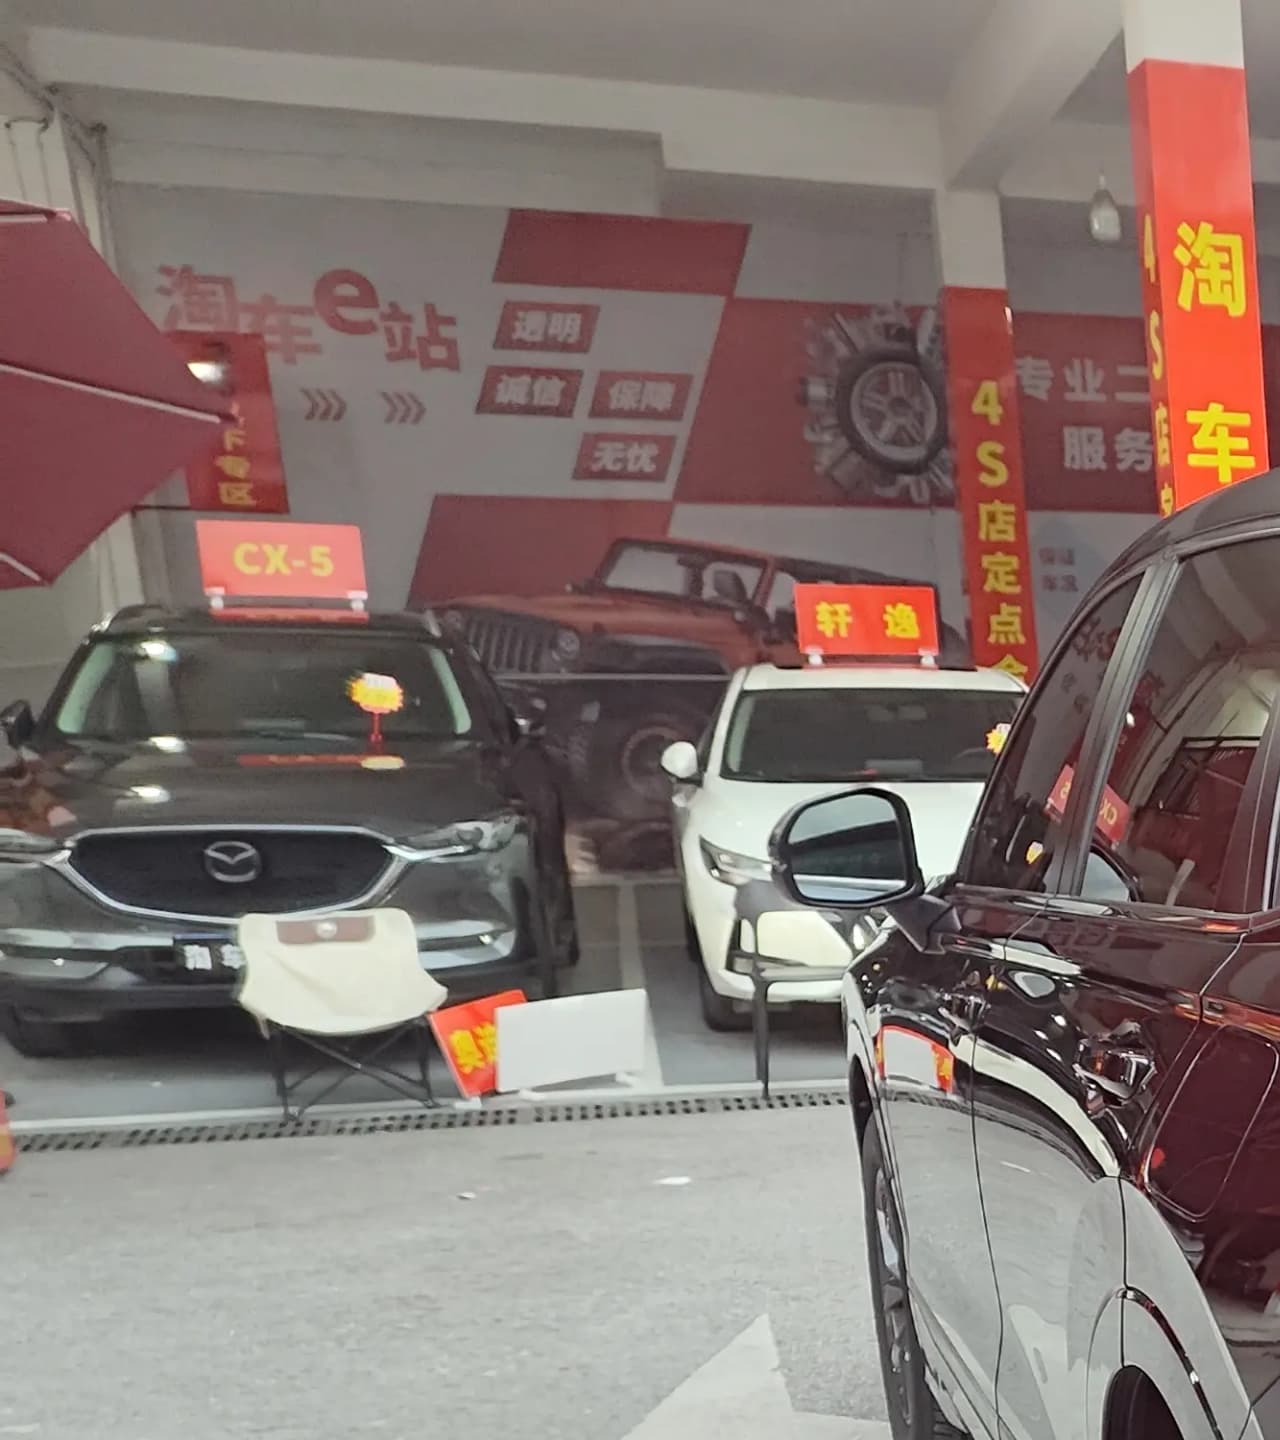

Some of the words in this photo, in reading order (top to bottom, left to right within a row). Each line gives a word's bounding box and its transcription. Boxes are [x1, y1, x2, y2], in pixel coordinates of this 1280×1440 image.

[155, 264, 461, 372] 淘车e站
[511, 310, 582, 343] 透明
[1173, 221, 1256, 483] 淘车
[590, 441, 660, 473] 无忧
[233, 542, 334, 577] CX-5
[815, 601, 920, 639] 轩逸
